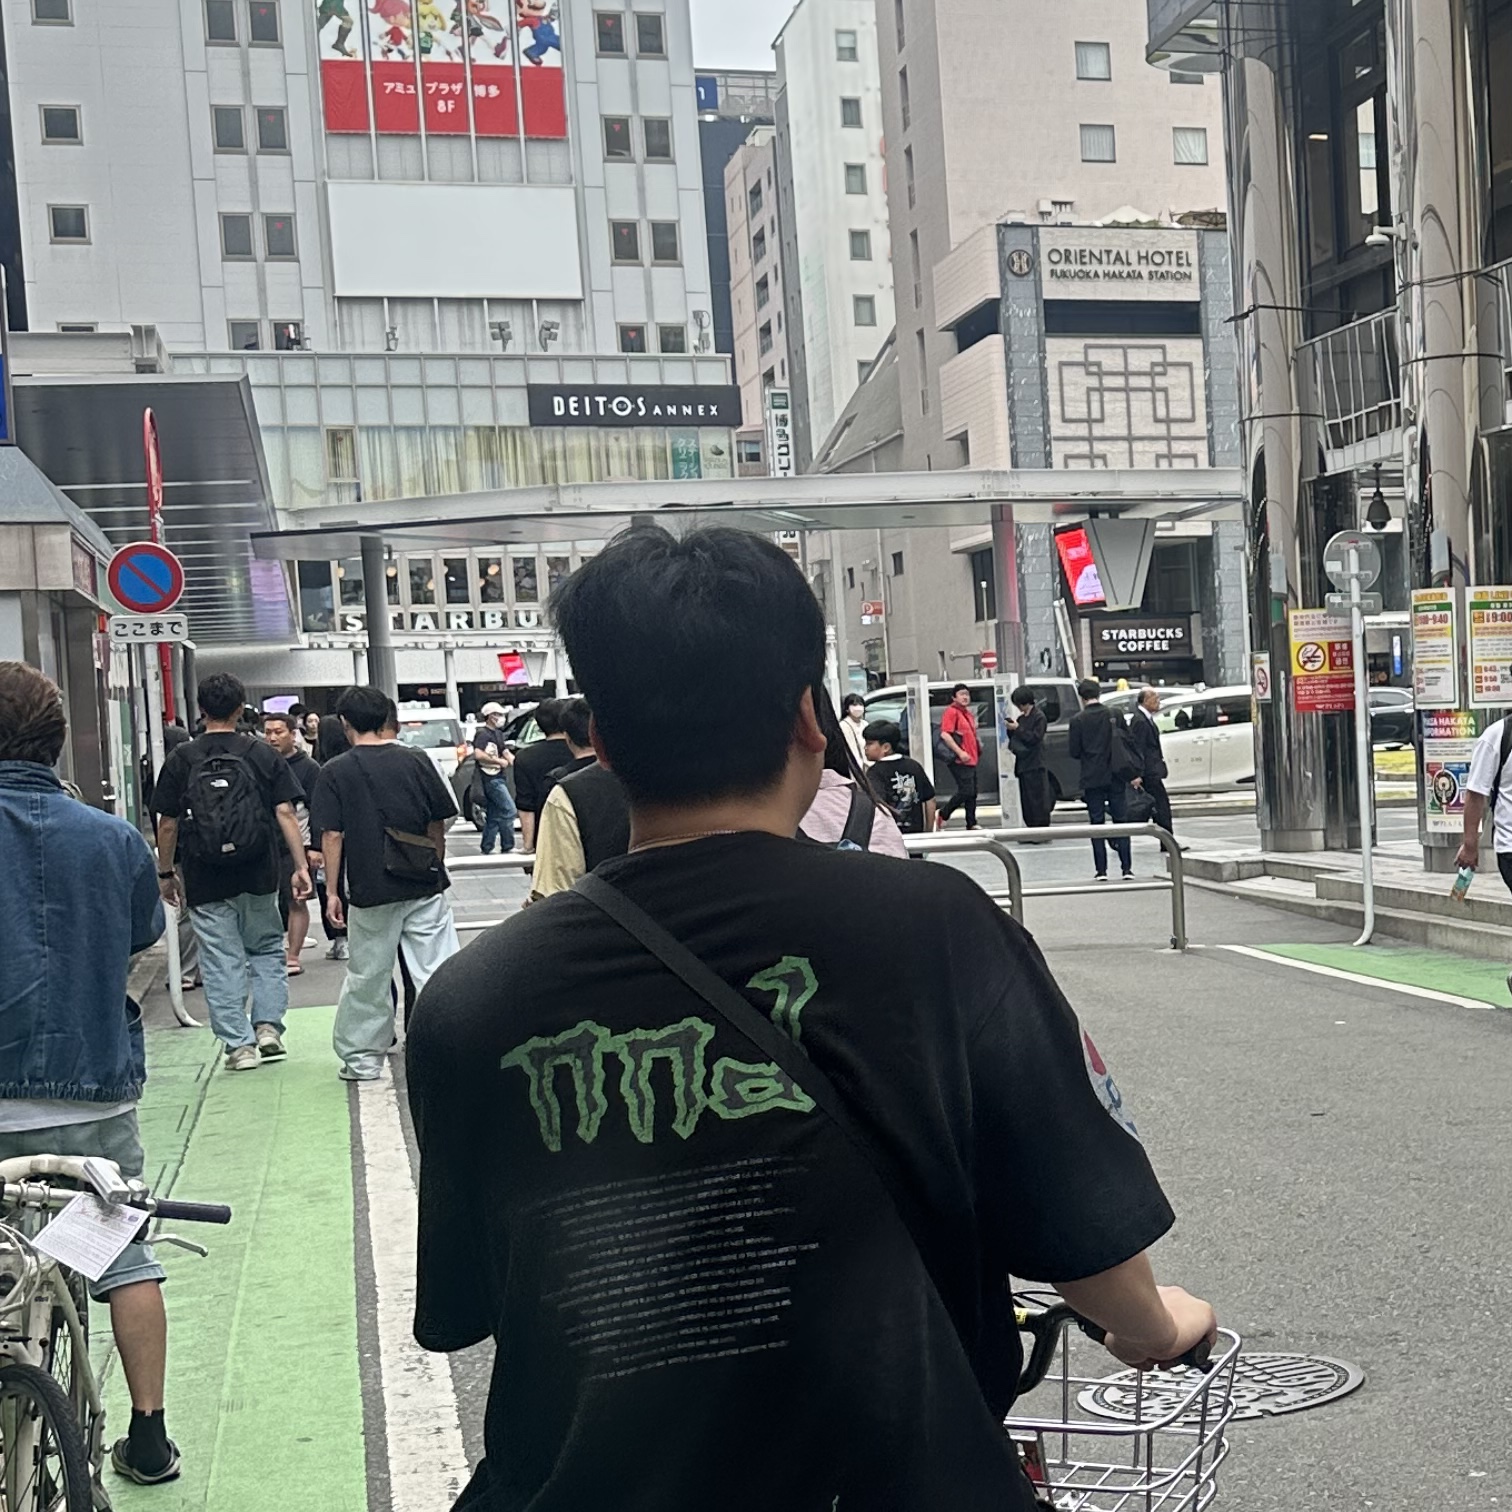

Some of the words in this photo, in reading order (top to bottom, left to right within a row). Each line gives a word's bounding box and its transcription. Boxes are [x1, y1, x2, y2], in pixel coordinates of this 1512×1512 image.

[1047, 248, 1132, 266] ORIENTAL
[1138, 250, 1192, 267] HOTEL
[1050, 269, 1100, 280] FUKUOKA
[1102, 269, 1143, 280] HAKATA
[1148, 270, 1192, 281] STATION
[553, 396, 646, 416] DEITOS
[653, 404, 718, 416] ANNEX
[114, 621, 182, 636] ここまで
[346, 612, 539, 632] STARBU
[1101, 628, 1183, 641] STARBUCKS
[1117, 640, 1169, 652] COFFEE
